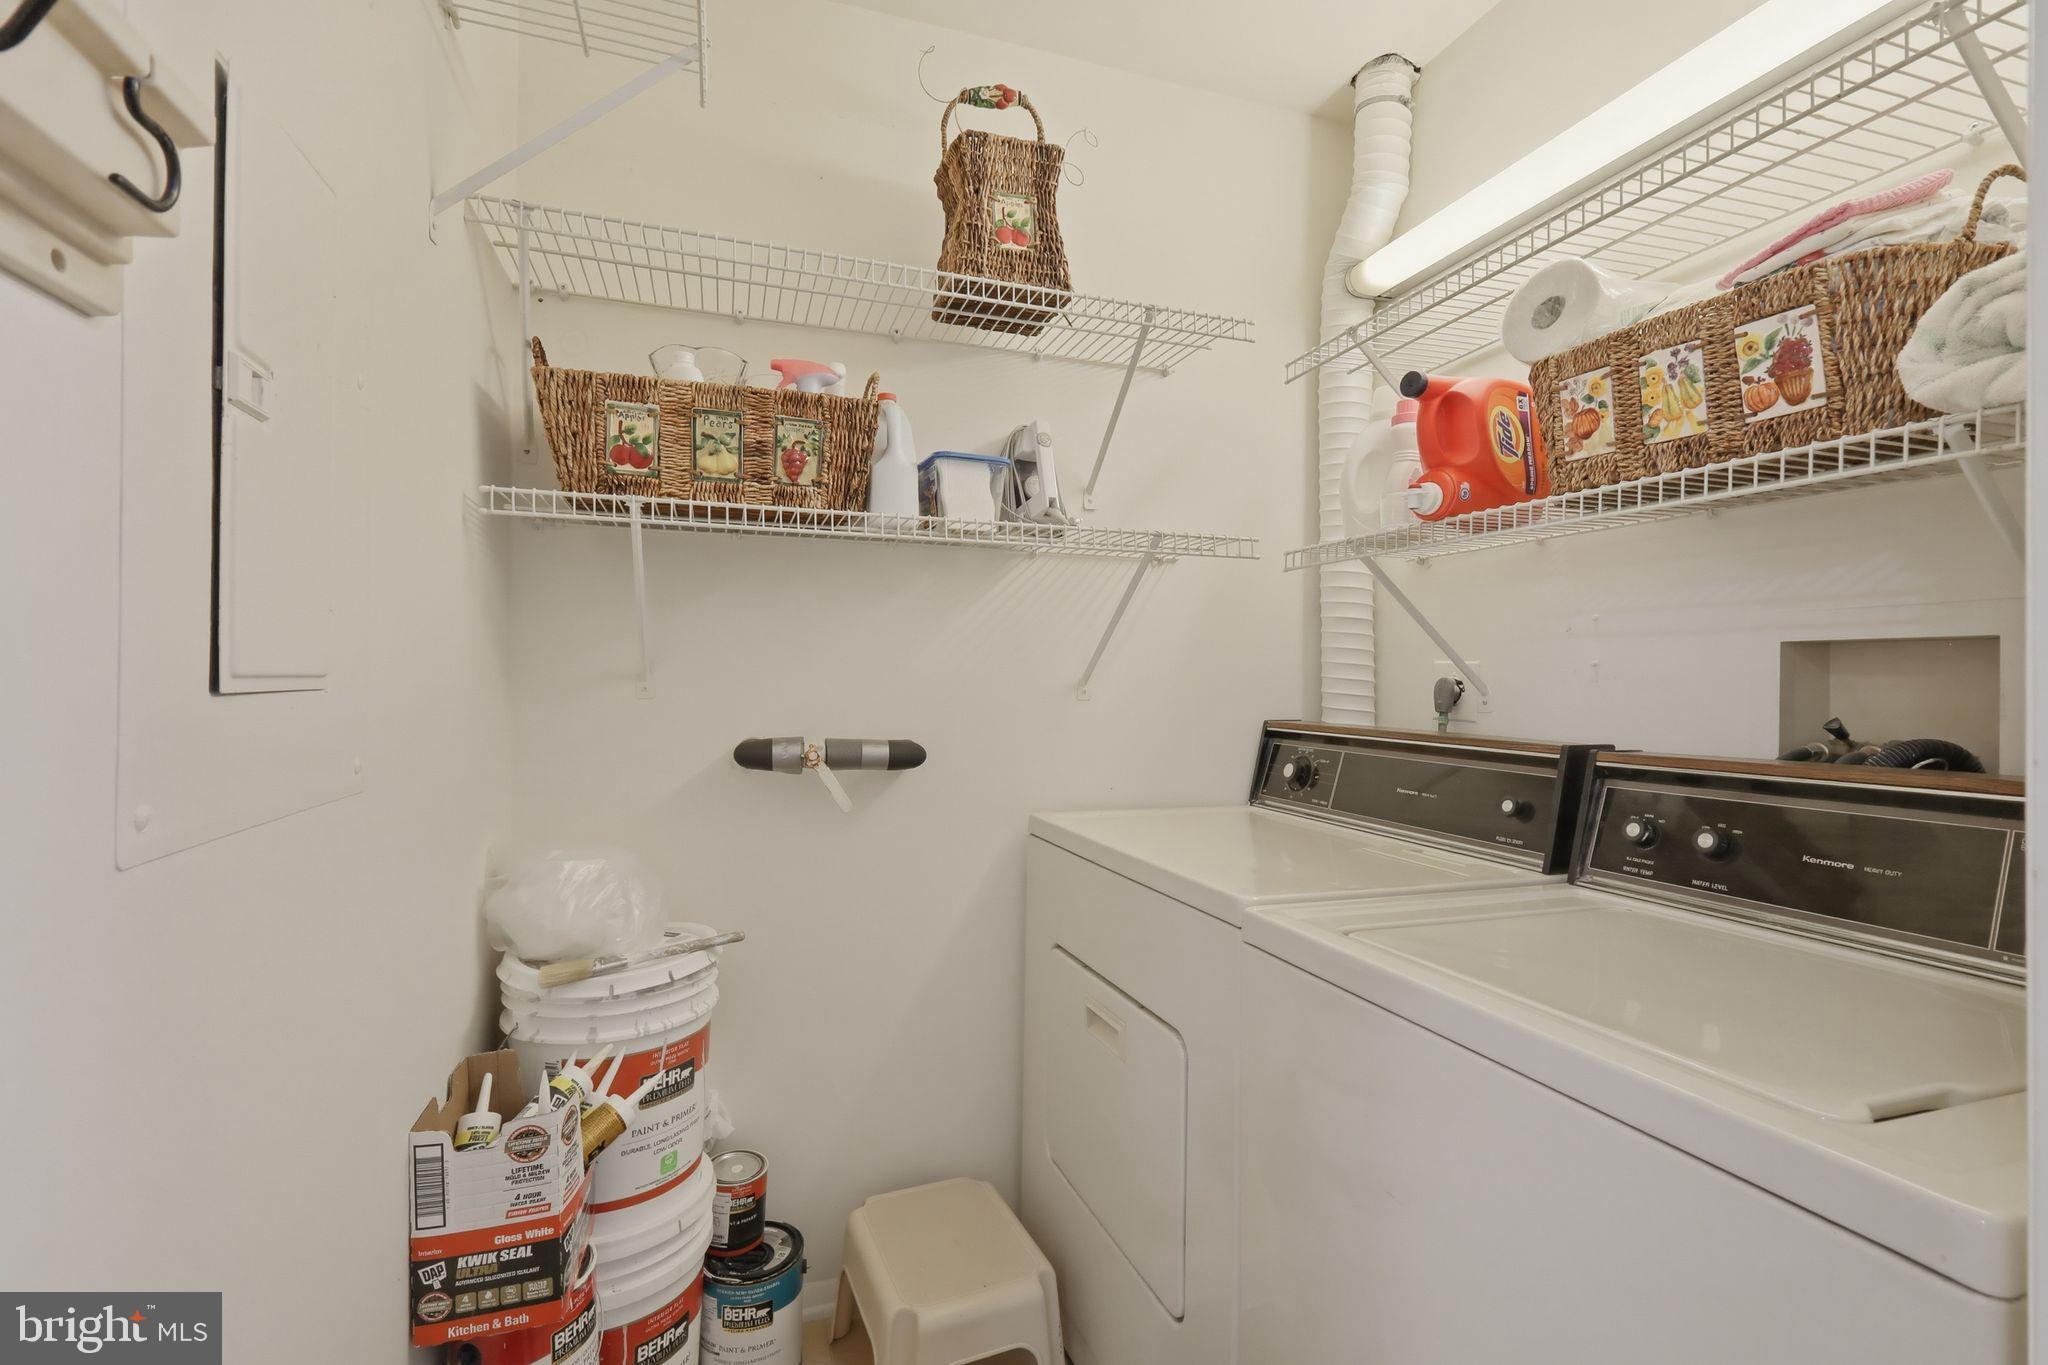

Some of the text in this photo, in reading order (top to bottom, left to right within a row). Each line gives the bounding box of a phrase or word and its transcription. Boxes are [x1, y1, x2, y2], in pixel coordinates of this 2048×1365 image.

[703, 414, 733, 430] Pears
[1498, 409, 1520, 459] Tide
[1640, 868, 1654, 876] TEMP
[1802, 854, 1855, 870] Kenmore
[1885, 869, 1903, 878] DUTY
[1692, 879, 1728, 892] WATER LEVEL
[631, 1103, 696, 1138] PAINT & PRIMER
[653, 1146, 667, 1156] LOW
[511, 1163, 544, 1174] LIFETIME
[528, 1168, 550, 1177] MILDEW
[511, 1175, 545, 1185] PROTECTION
[514, 1191, 542, 1201] 4 HOUR
[494, 1226, 555, 1246] Gloss White
[457, 1245, 534, 1269] KWIK SEAL
[421, 1264, 446, 1283] DAP
[455, 1263, 499, 1280] ULTRA
[724, 1307, 757, 1322] BEHR
[447, 1313, 530, 1339] Kitchen & Bath
[554, 1310, 589, 1351] BEHR
[637, 1327, 675, 1363] BEHR
[718, 1345, 739, 1354] PAINT
[747, 1340, 774, 1352] PRIMER
